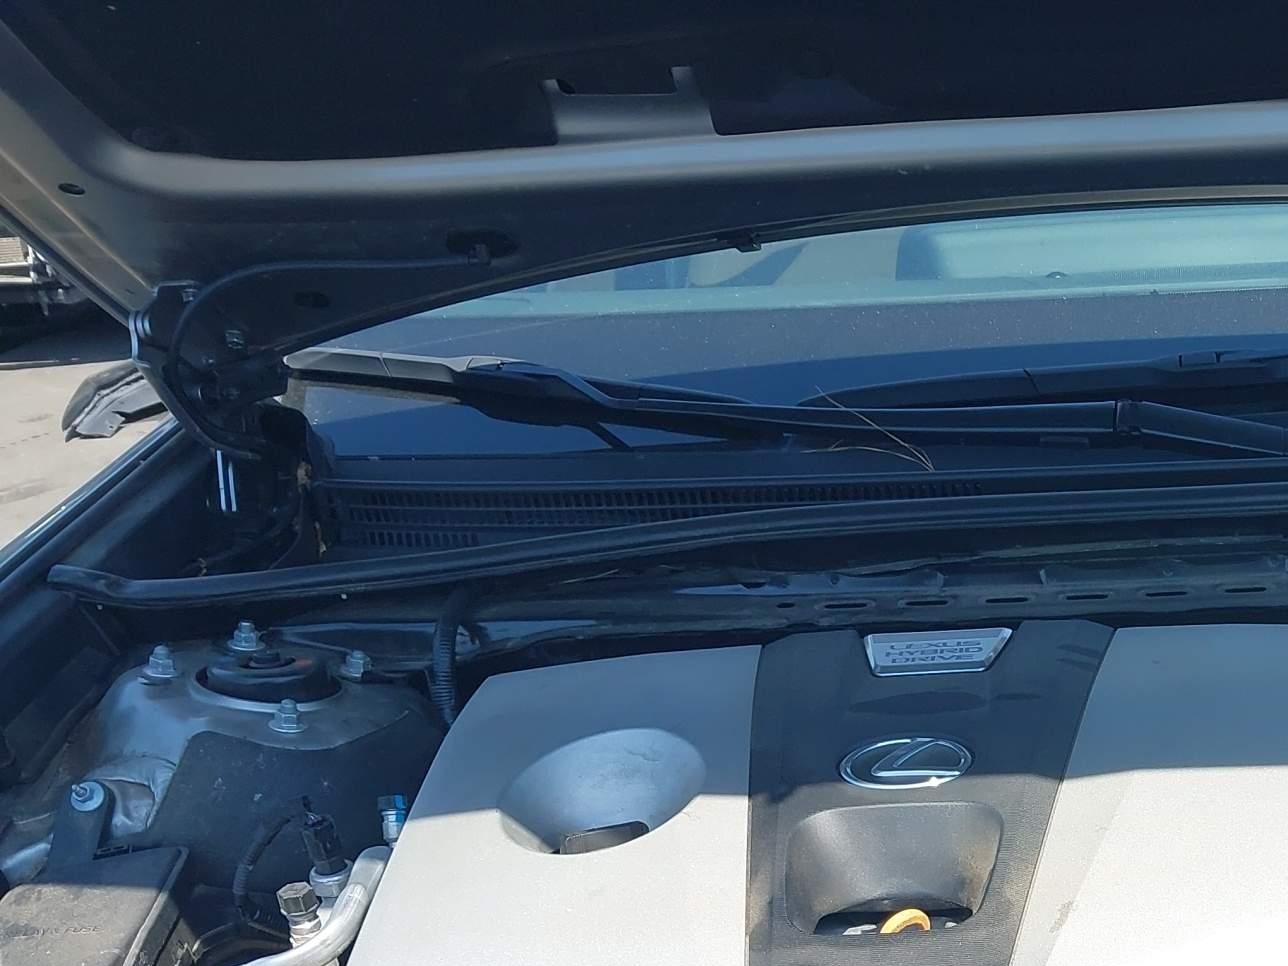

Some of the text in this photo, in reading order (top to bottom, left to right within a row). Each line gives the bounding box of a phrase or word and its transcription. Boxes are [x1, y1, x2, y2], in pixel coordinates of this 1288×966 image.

[890, 641, 982, 650] LEXUS
[885, 647, 983, 656] HYBRID
[891, 654, 974, 663] DRIVE
